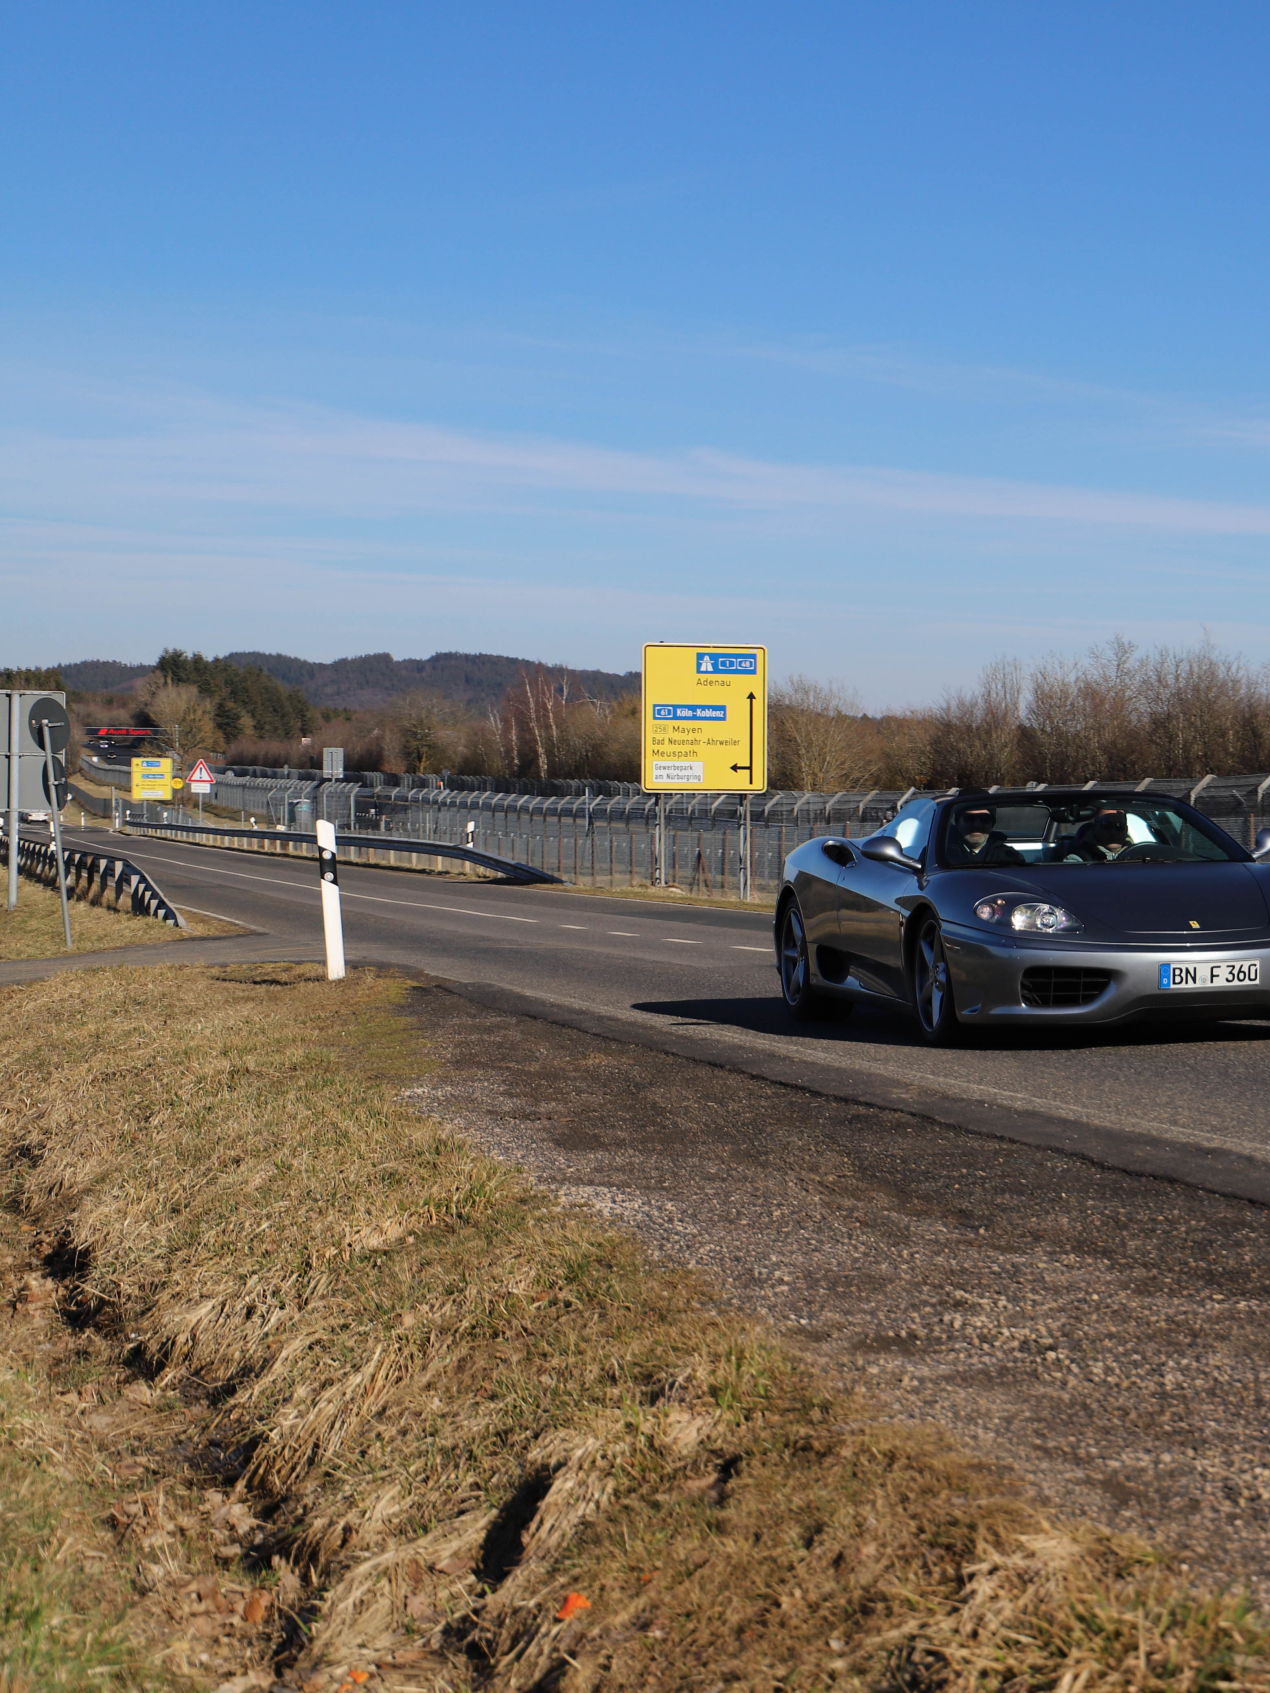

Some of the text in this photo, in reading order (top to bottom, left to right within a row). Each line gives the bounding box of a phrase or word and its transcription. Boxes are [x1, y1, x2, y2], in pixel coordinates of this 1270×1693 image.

[741, 660, 750, 668] 48
[696, 678, 731, 687] Adenau
[676, 708, 725, 718] Köln-Koblenz
[128, 728, 151, 736] Sport
[654, 725, 703, 735] 258 Mayen
[652, 737, 665, 746] Bad
[652, 749, 698, 759] Meuspath
[654, 763, 694, 772] Gewerbepark
[666, 772, 702, 782] Nürburgring
[1172, 966, 1197, 985] BN
[1210, 965, 1222, 984] F
[1225, 963, 1258, 983] 360
